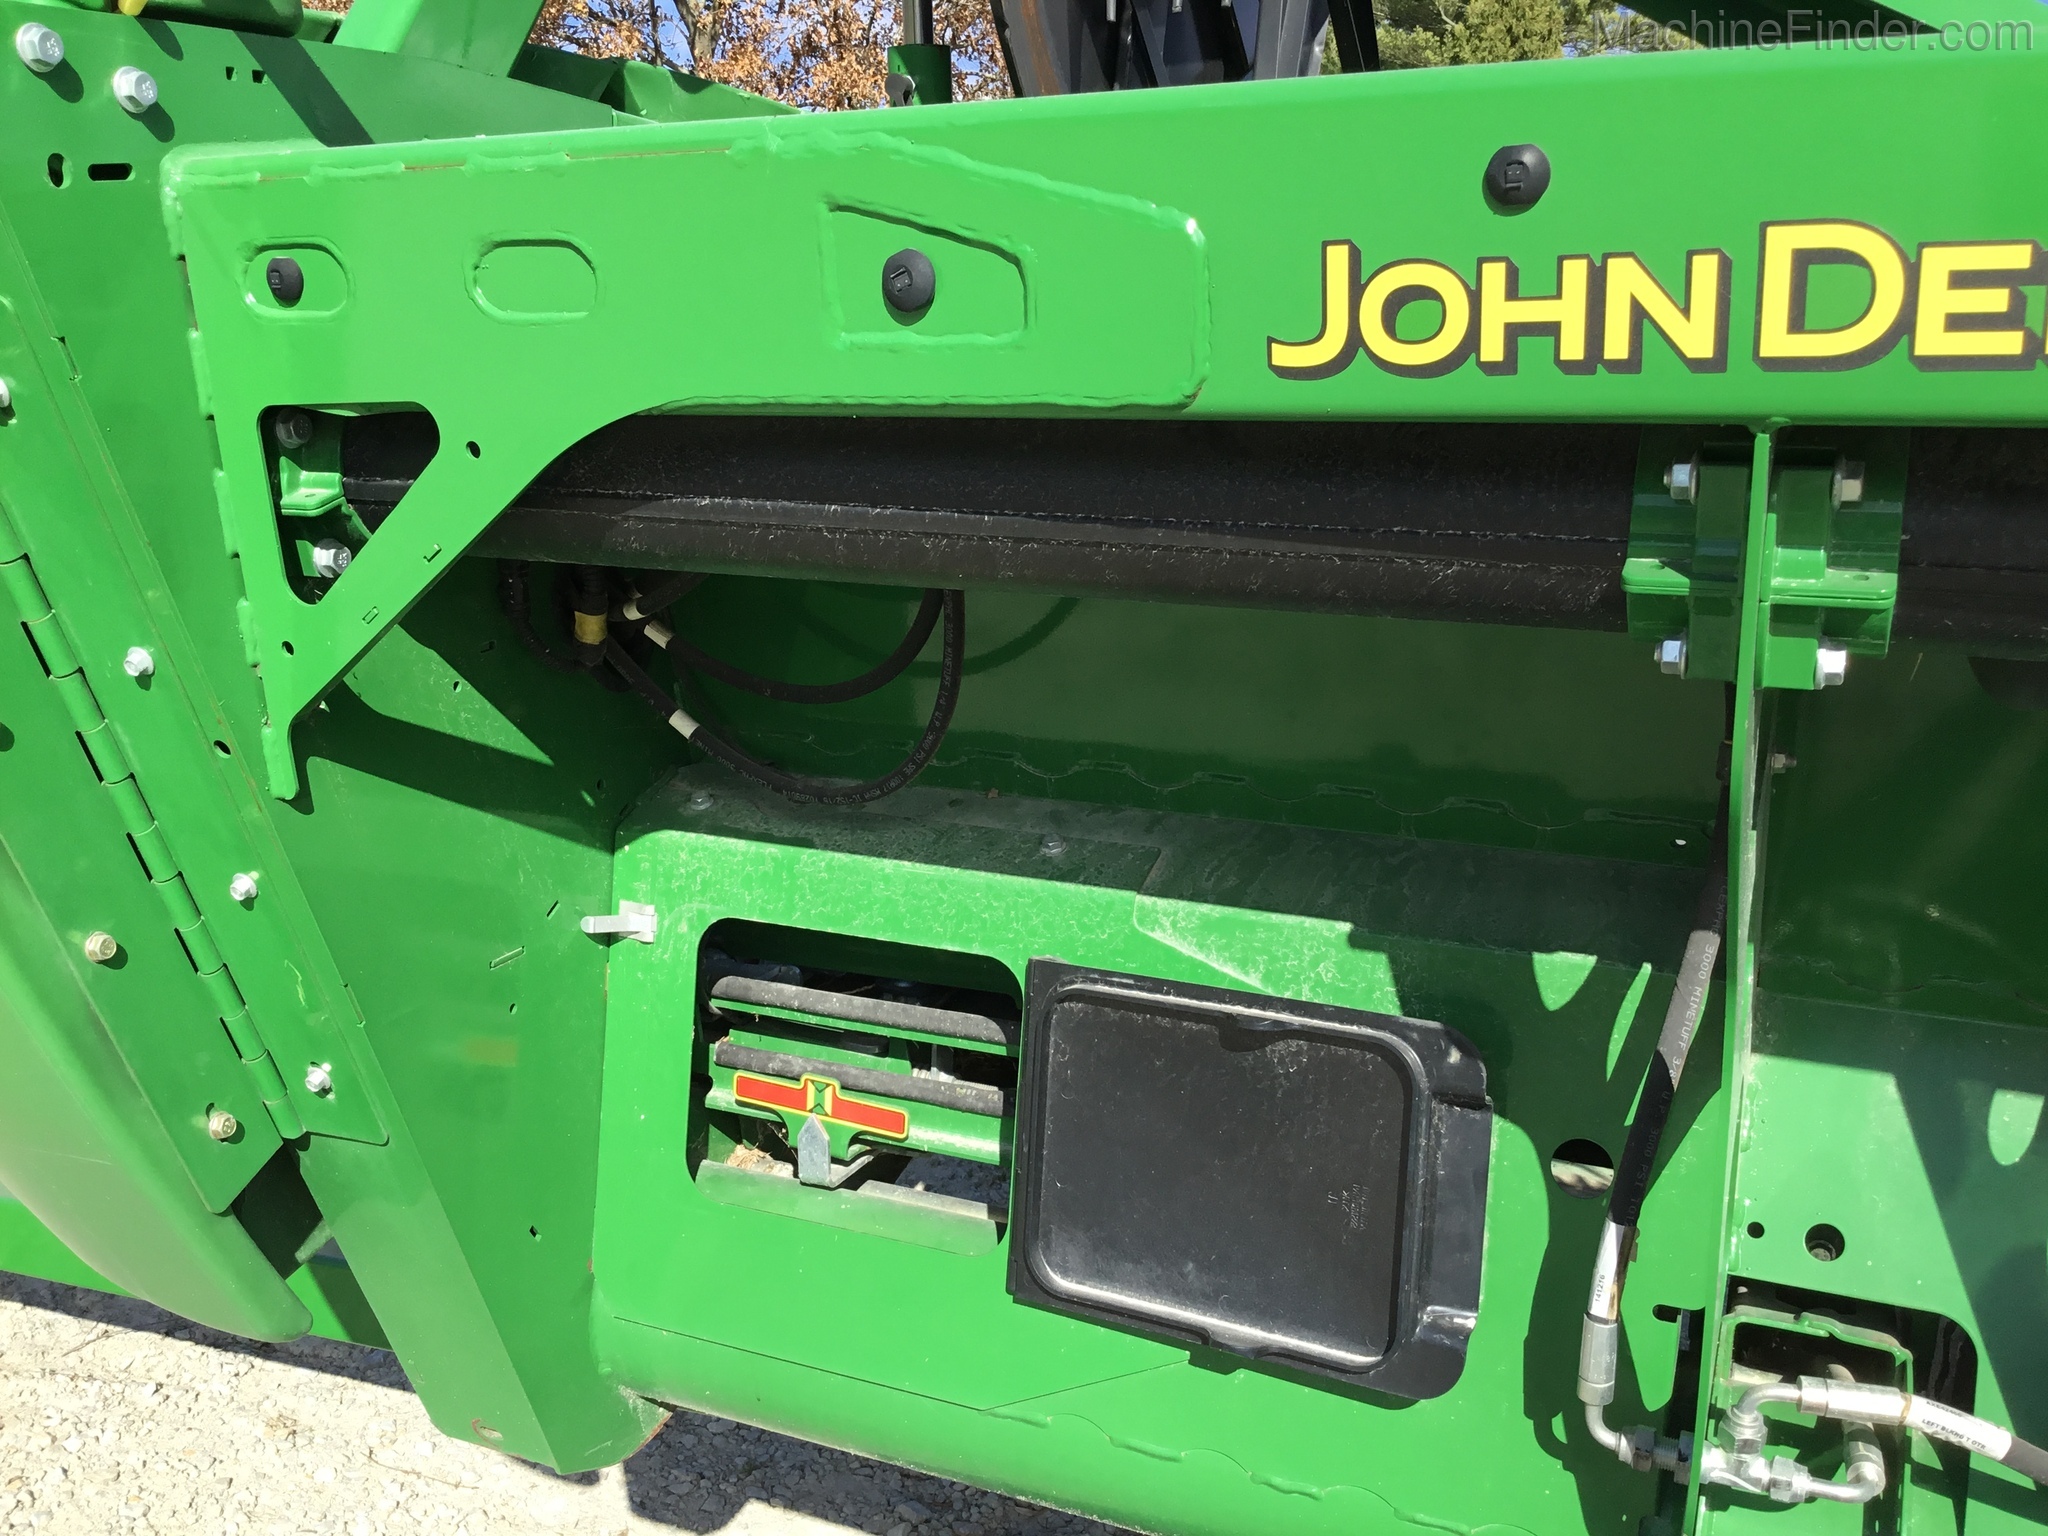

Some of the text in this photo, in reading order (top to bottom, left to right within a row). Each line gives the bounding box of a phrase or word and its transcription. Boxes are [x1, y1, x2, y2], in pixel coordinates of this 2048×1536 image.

[1267, 218, 2048, 380] JOHN DE
[1698, 944, 1715, 980] 3000
[1678, 986, 1703, 1051] MINETUFF
[1643, 1127, 1659, 1158] 3000
[1634, 1163, 1649, 1187] PSI
[1922, 1419, 1940, 1429] LEFT
